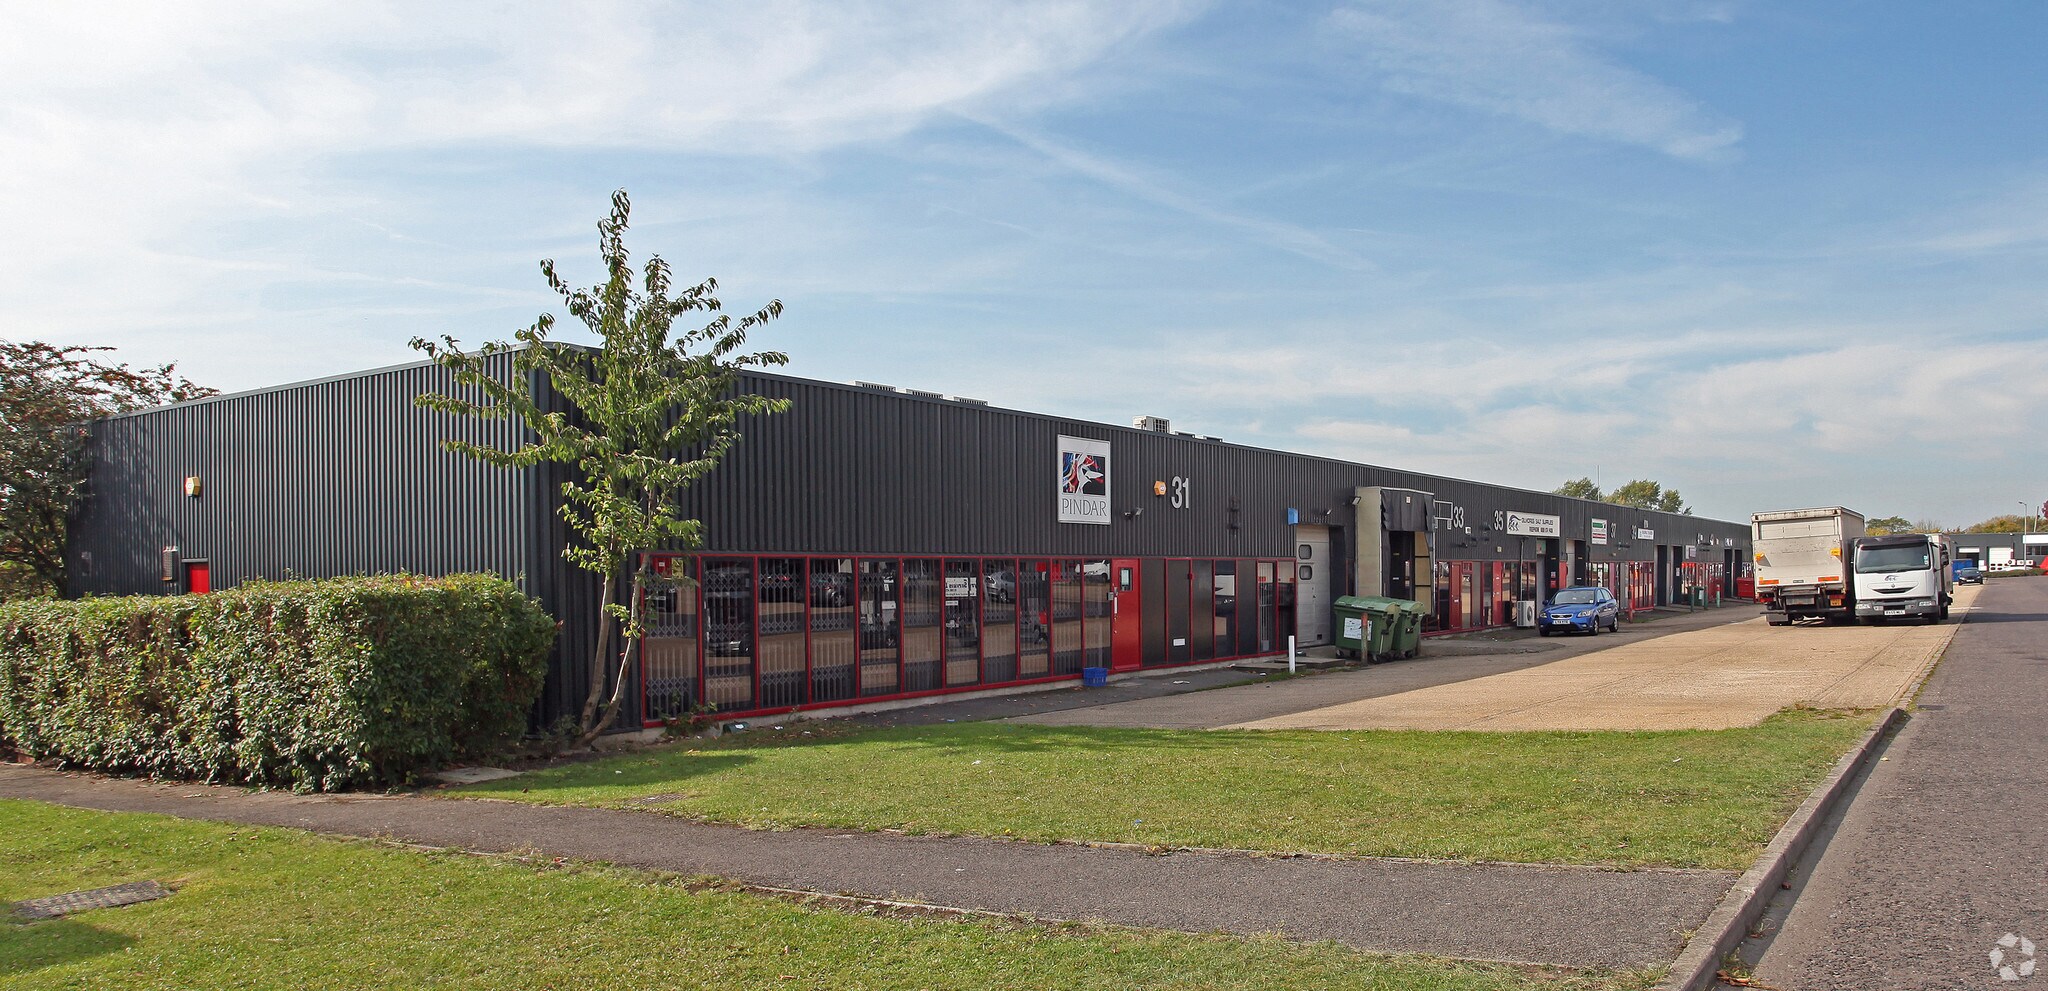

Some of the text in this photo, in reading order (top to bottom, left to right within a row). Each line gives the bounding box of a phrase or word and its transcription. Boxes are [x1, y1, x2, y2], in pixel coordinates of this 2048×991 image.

[1171, 475, 1189, 509] 31
[1062, 498, 1107, 517] PINDAR
[1453, 506, 1464, 528] 33
[1494, 510, 1504, 531] 35
